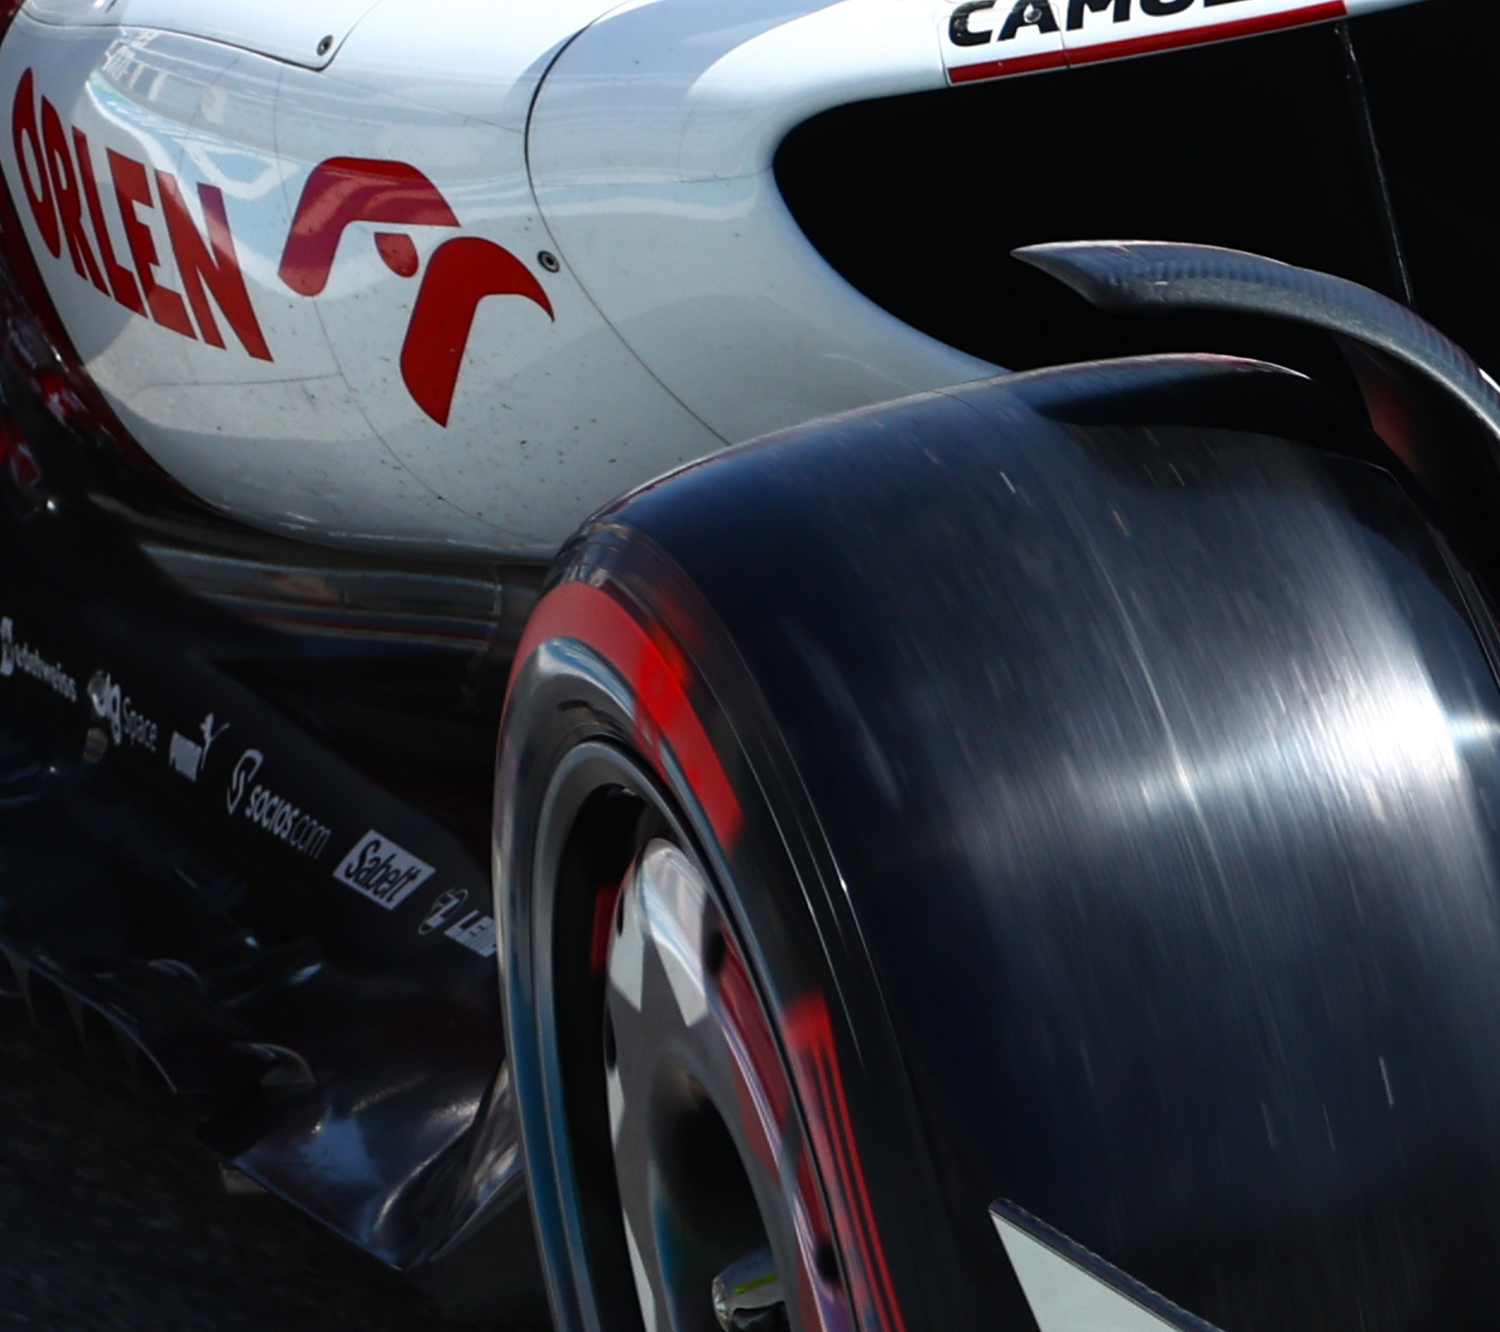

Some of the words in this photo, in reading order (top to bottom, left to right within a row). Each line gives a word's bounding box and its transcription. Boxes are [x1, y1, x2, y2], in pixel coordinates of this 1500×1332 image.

[10, 67, 275, 364] ORLEN
[245, 784, 332, 860] socios.com
[345, 838, 423, 905] Sabelt
